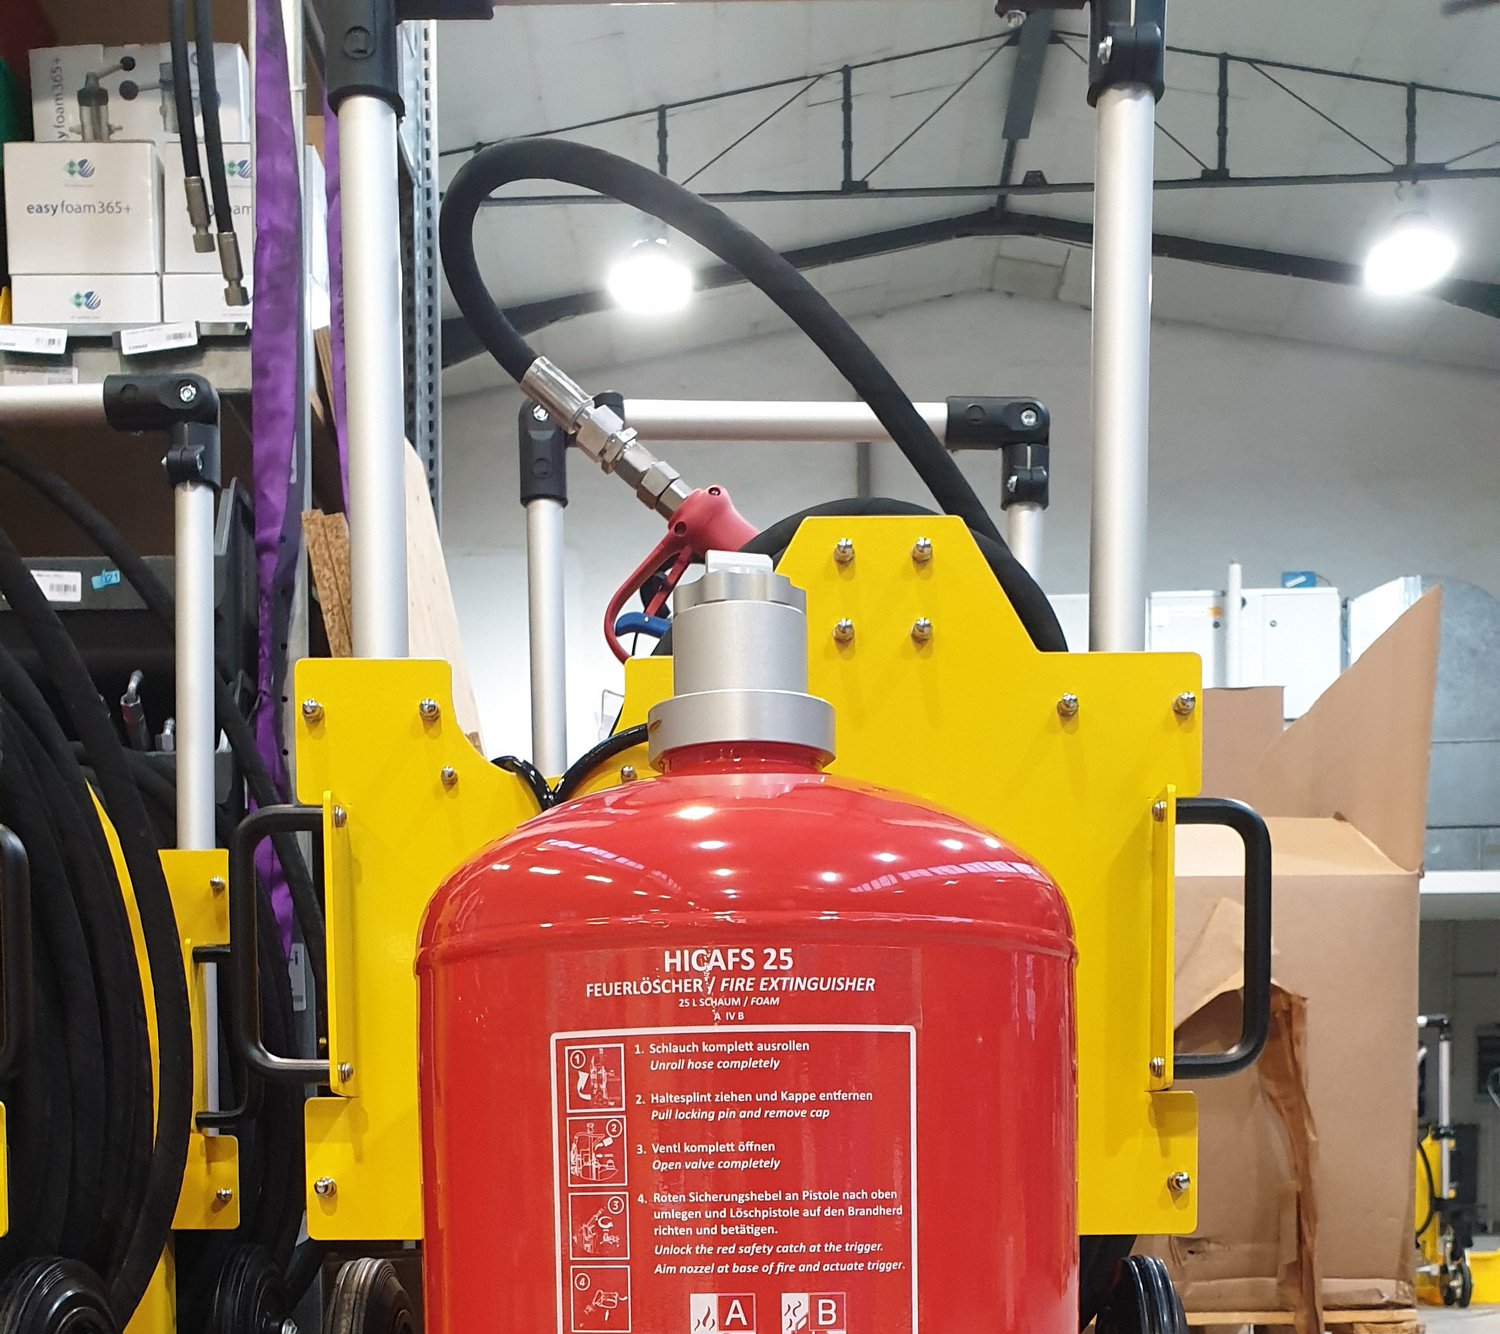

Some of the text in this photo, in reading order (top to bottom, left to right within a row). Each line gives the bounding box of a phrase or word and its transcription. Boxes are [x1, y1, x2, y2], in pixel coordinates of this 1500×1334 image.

[664, 947, 793, 973] HICAFS 25
[586, 976, 876, 998] FEUERLÖSCHER / FIRE EXTINGUISHER
[679, 996, 780, 1008] 25 L SCHAUM / FOAM
[713, 1011, 744, 1021] A IV B
[634, 1040, 810, 1054] 1. Schlauch komplett ausrollen
[650, 1057, 780, 1071] Unroll hose completely
[635, 1089, 873, 1105] 2. Haltesplint ziehen und Kappe entfernen
[651, 1107, 830, 1122] Pull locking pin and remove cap
[636, 1144, 647, 1154] 3.
[684, 1141, 735, 1155] komplett
[738, 1141, 775, 1152] öffnen
[652, 1157, 781, 1172] Open valve completely
[637, 1188, 898, 1204] 4. Roten Sicherungshebel an Pistole nach oben
[654, 1205, 903, 1221] umlegen und Löschpistole auf den Brandherd
[654, 1224, 778, 1237] richten und betätigen.
[654, 1241, 883, 1256] Unlock the red safety catch at the trigger.
[654, 1260, 905, 1275] Aim nozzel at base of fire and actuate trigger.
[725, 1299, 837, 1327] A B
